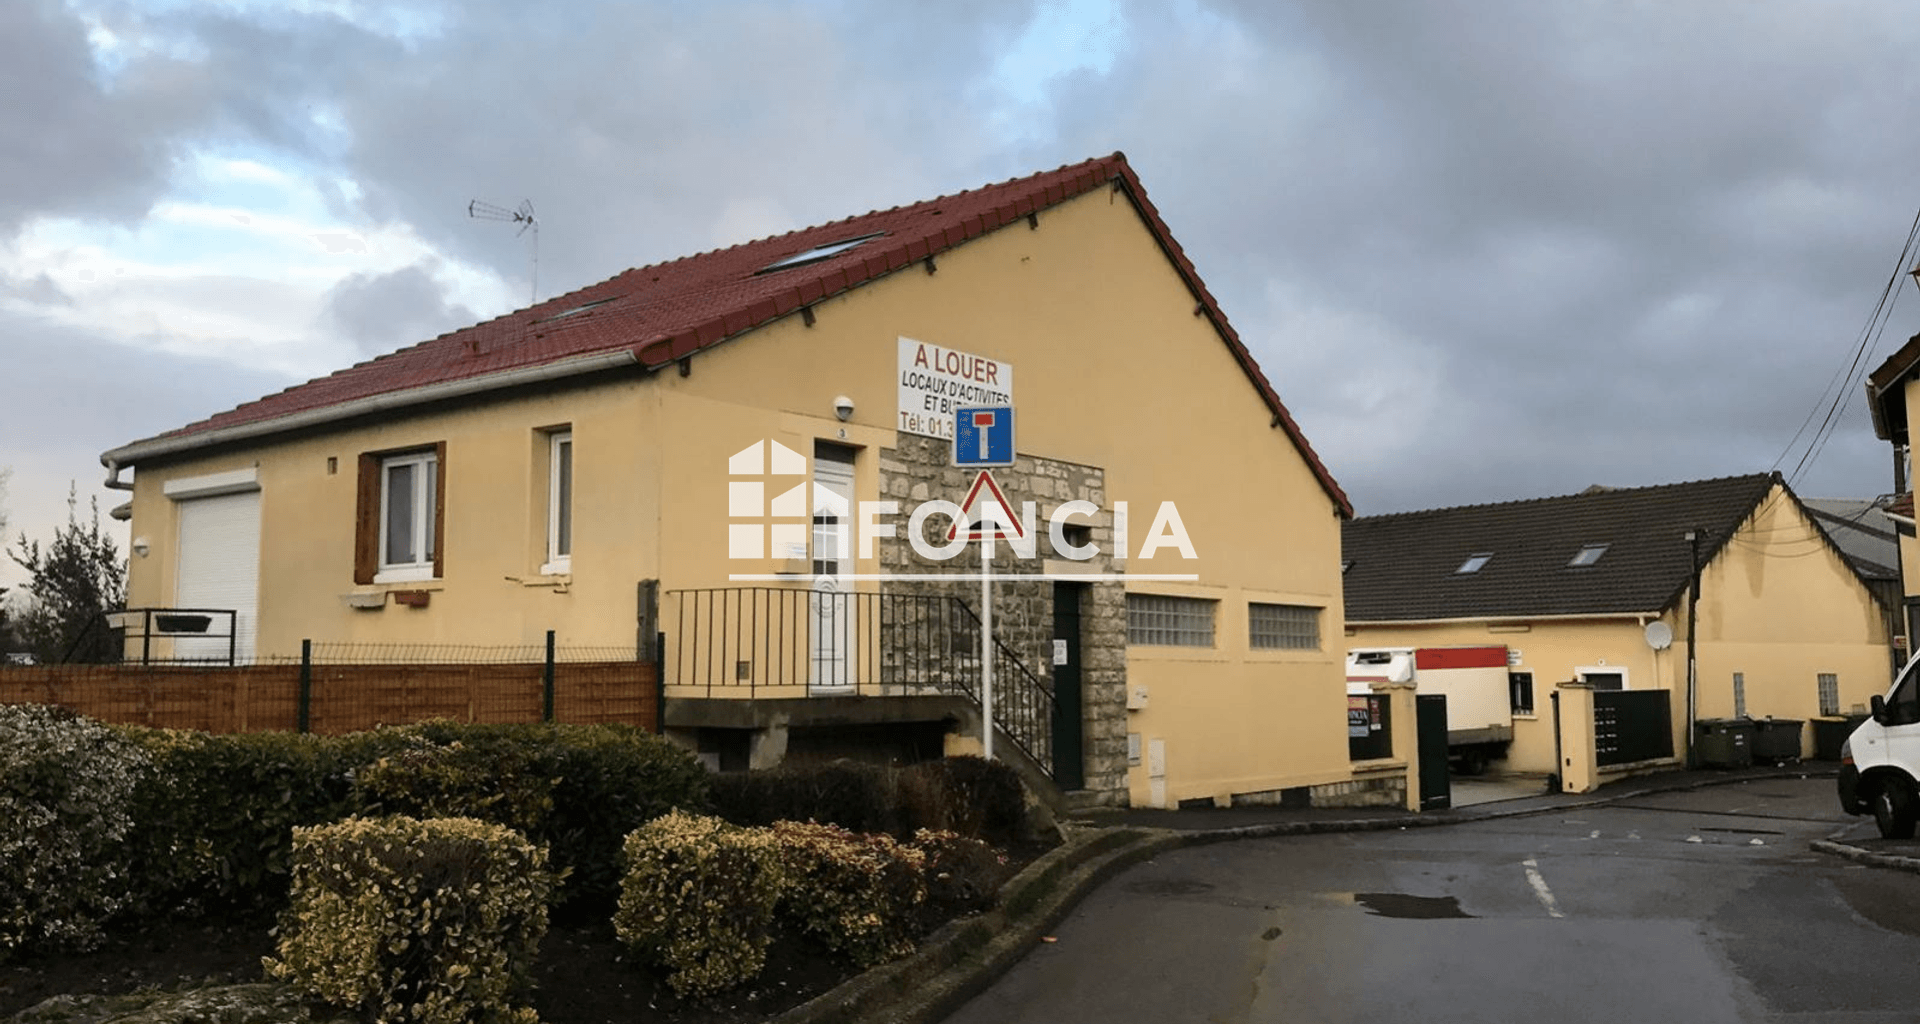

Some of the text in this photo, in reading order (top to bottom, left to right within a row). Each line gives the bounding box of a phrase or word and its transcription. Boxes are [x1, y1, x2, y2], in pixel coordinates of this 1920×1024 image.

[915, 344, 998, 386] A LOUER
[902, 369, 947, 396] LOCAUX
[924, 394, 939, 411] ET
